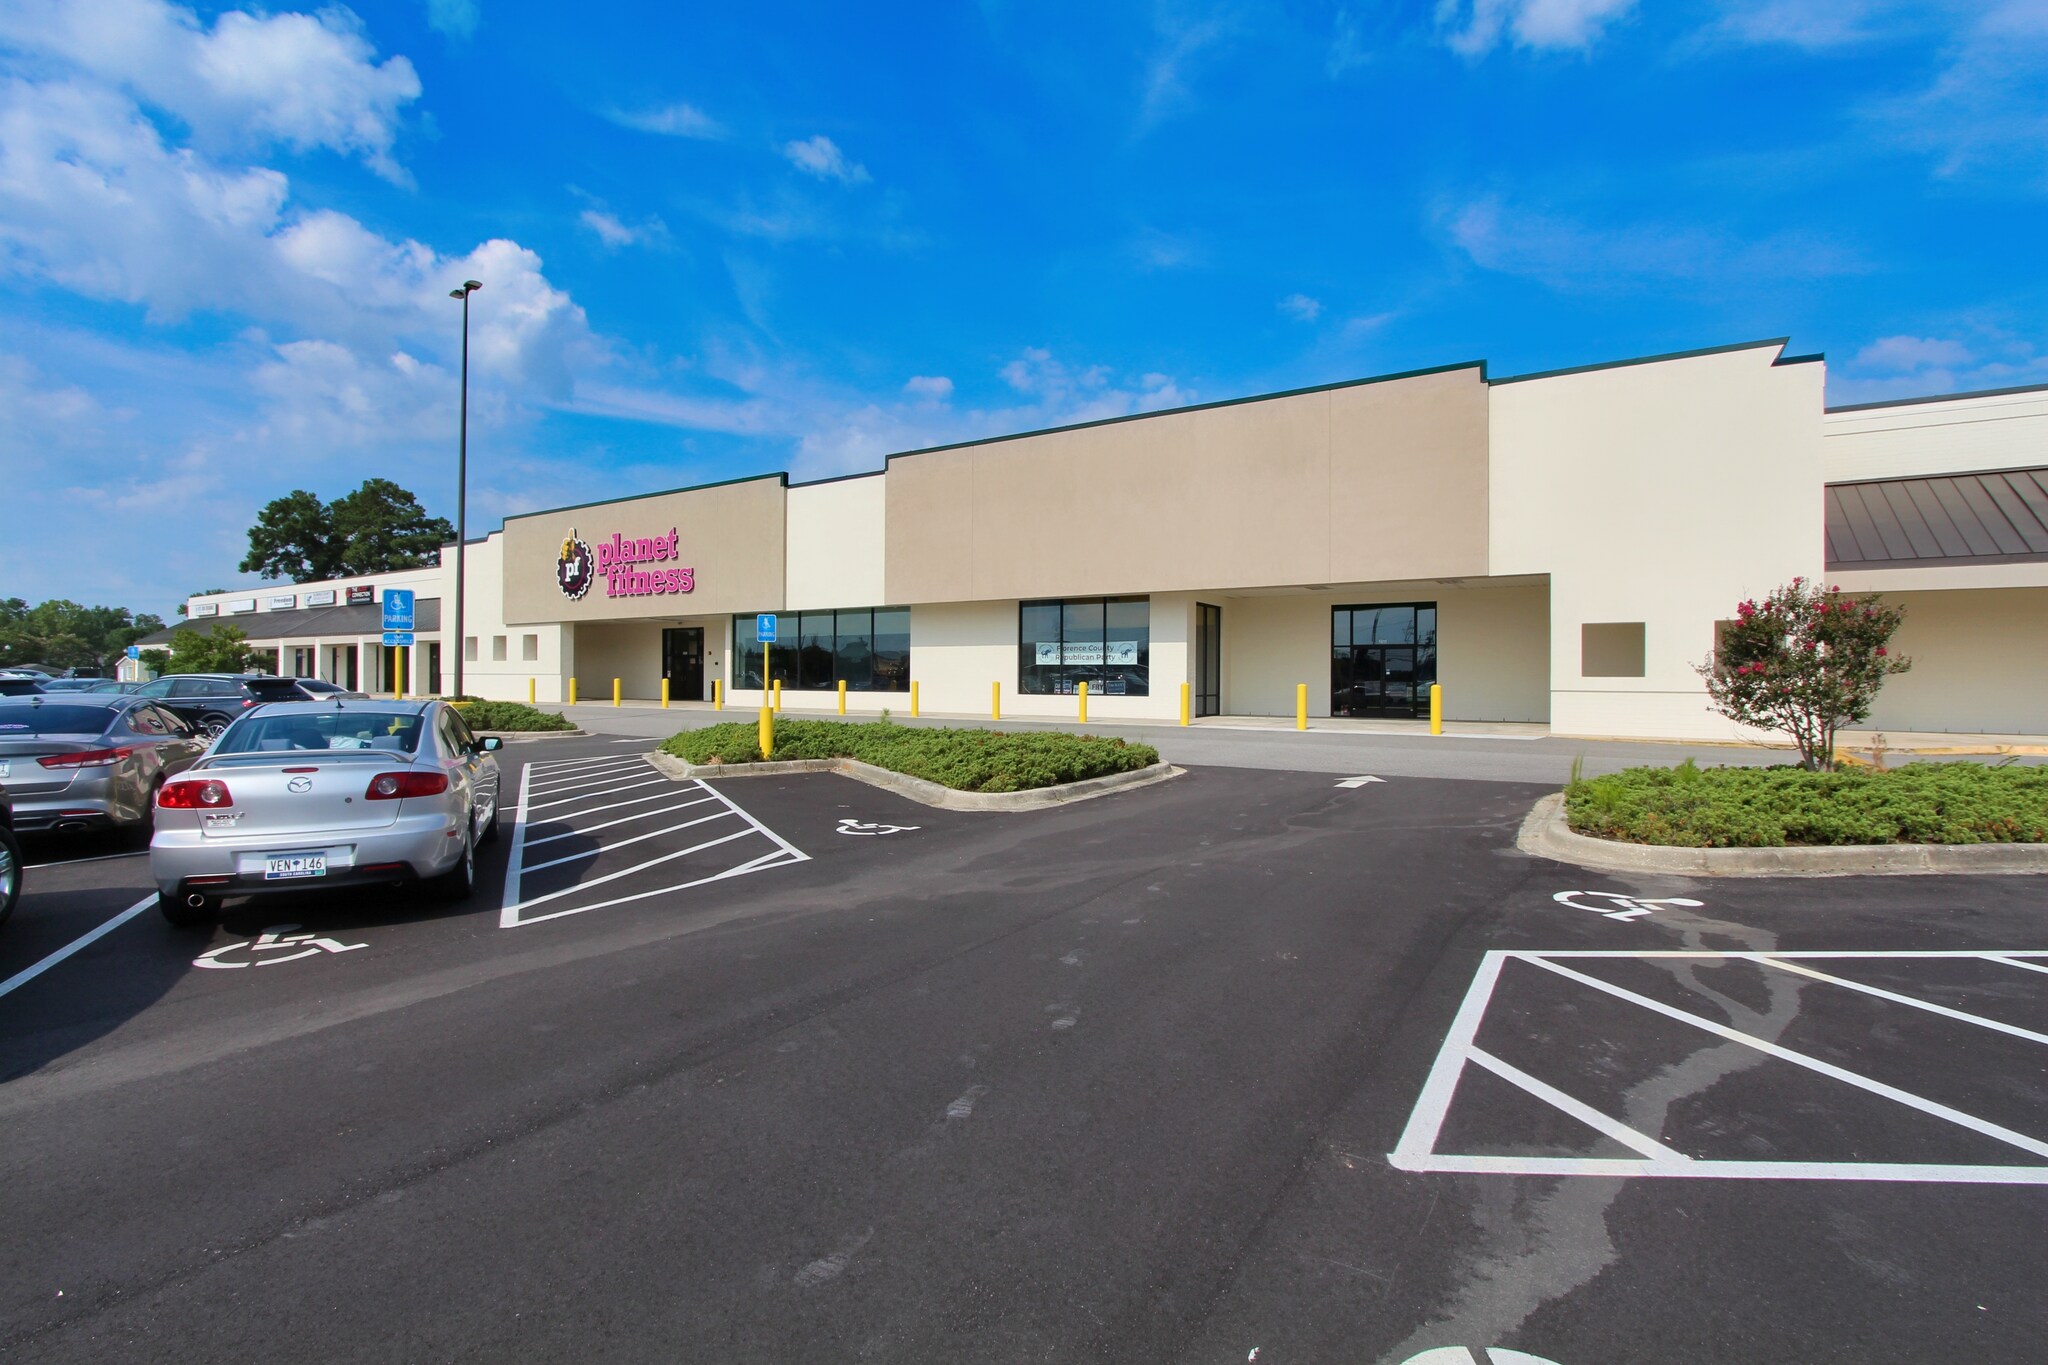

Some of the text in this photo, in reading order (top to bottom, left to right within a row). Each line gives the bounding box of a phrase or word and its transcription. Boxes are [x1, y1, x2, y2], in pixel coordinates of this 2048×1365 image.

[597, 527, 677, 574] planet
[565, 557, 580, 582] pf
[606, 565, 694, 597] fitness
[384, 614, 413, 623] PARKING
[1088, 645, 1114, 653] Couty
[1055, 654, 1095, 662] Rpublican
[270, 858, 322, 871] VEN 146
